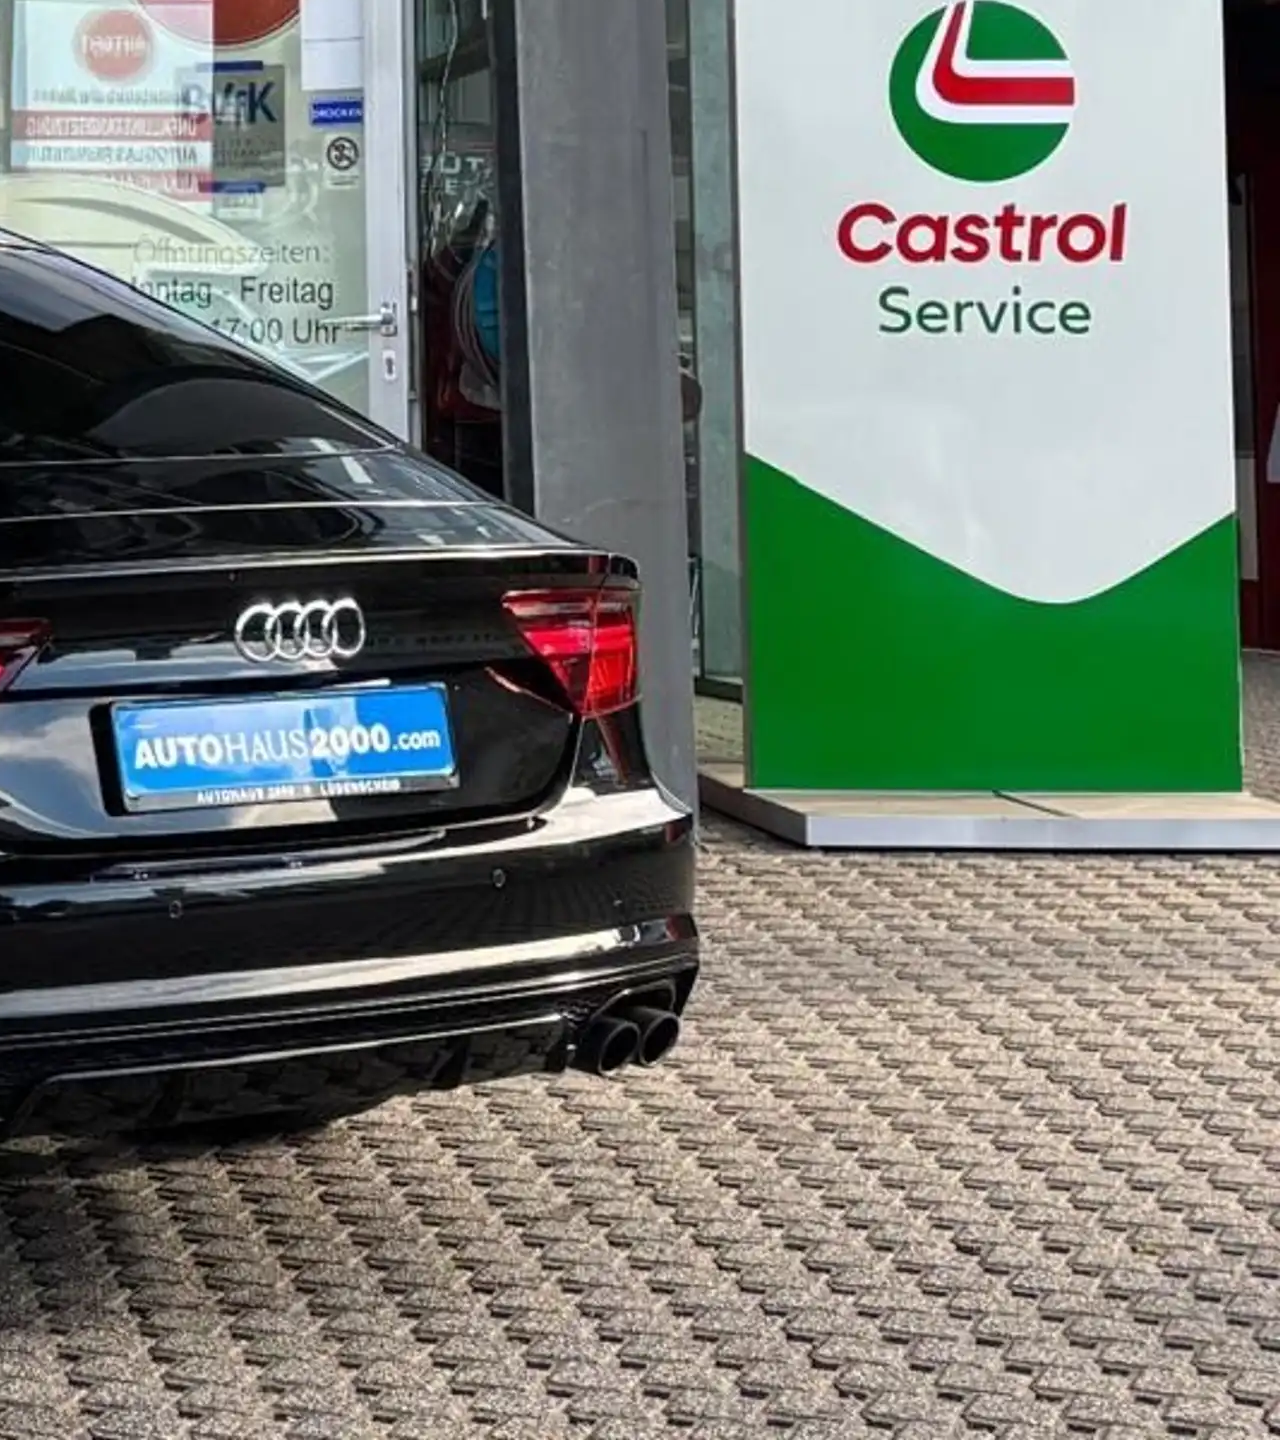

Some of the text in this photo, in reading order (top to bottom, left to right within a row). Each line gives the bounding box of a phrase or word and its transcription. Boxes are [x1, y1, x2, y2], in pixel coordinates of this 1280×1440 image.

[836, 202, 1128, 264] Castrol
[239, 276, 334, 310] Freitag
[877, 285, 1092, 335] Service
[293, 317, 340, 345] Uhr
[134, 722, 441, 770] AUTOHAUS2000.com
